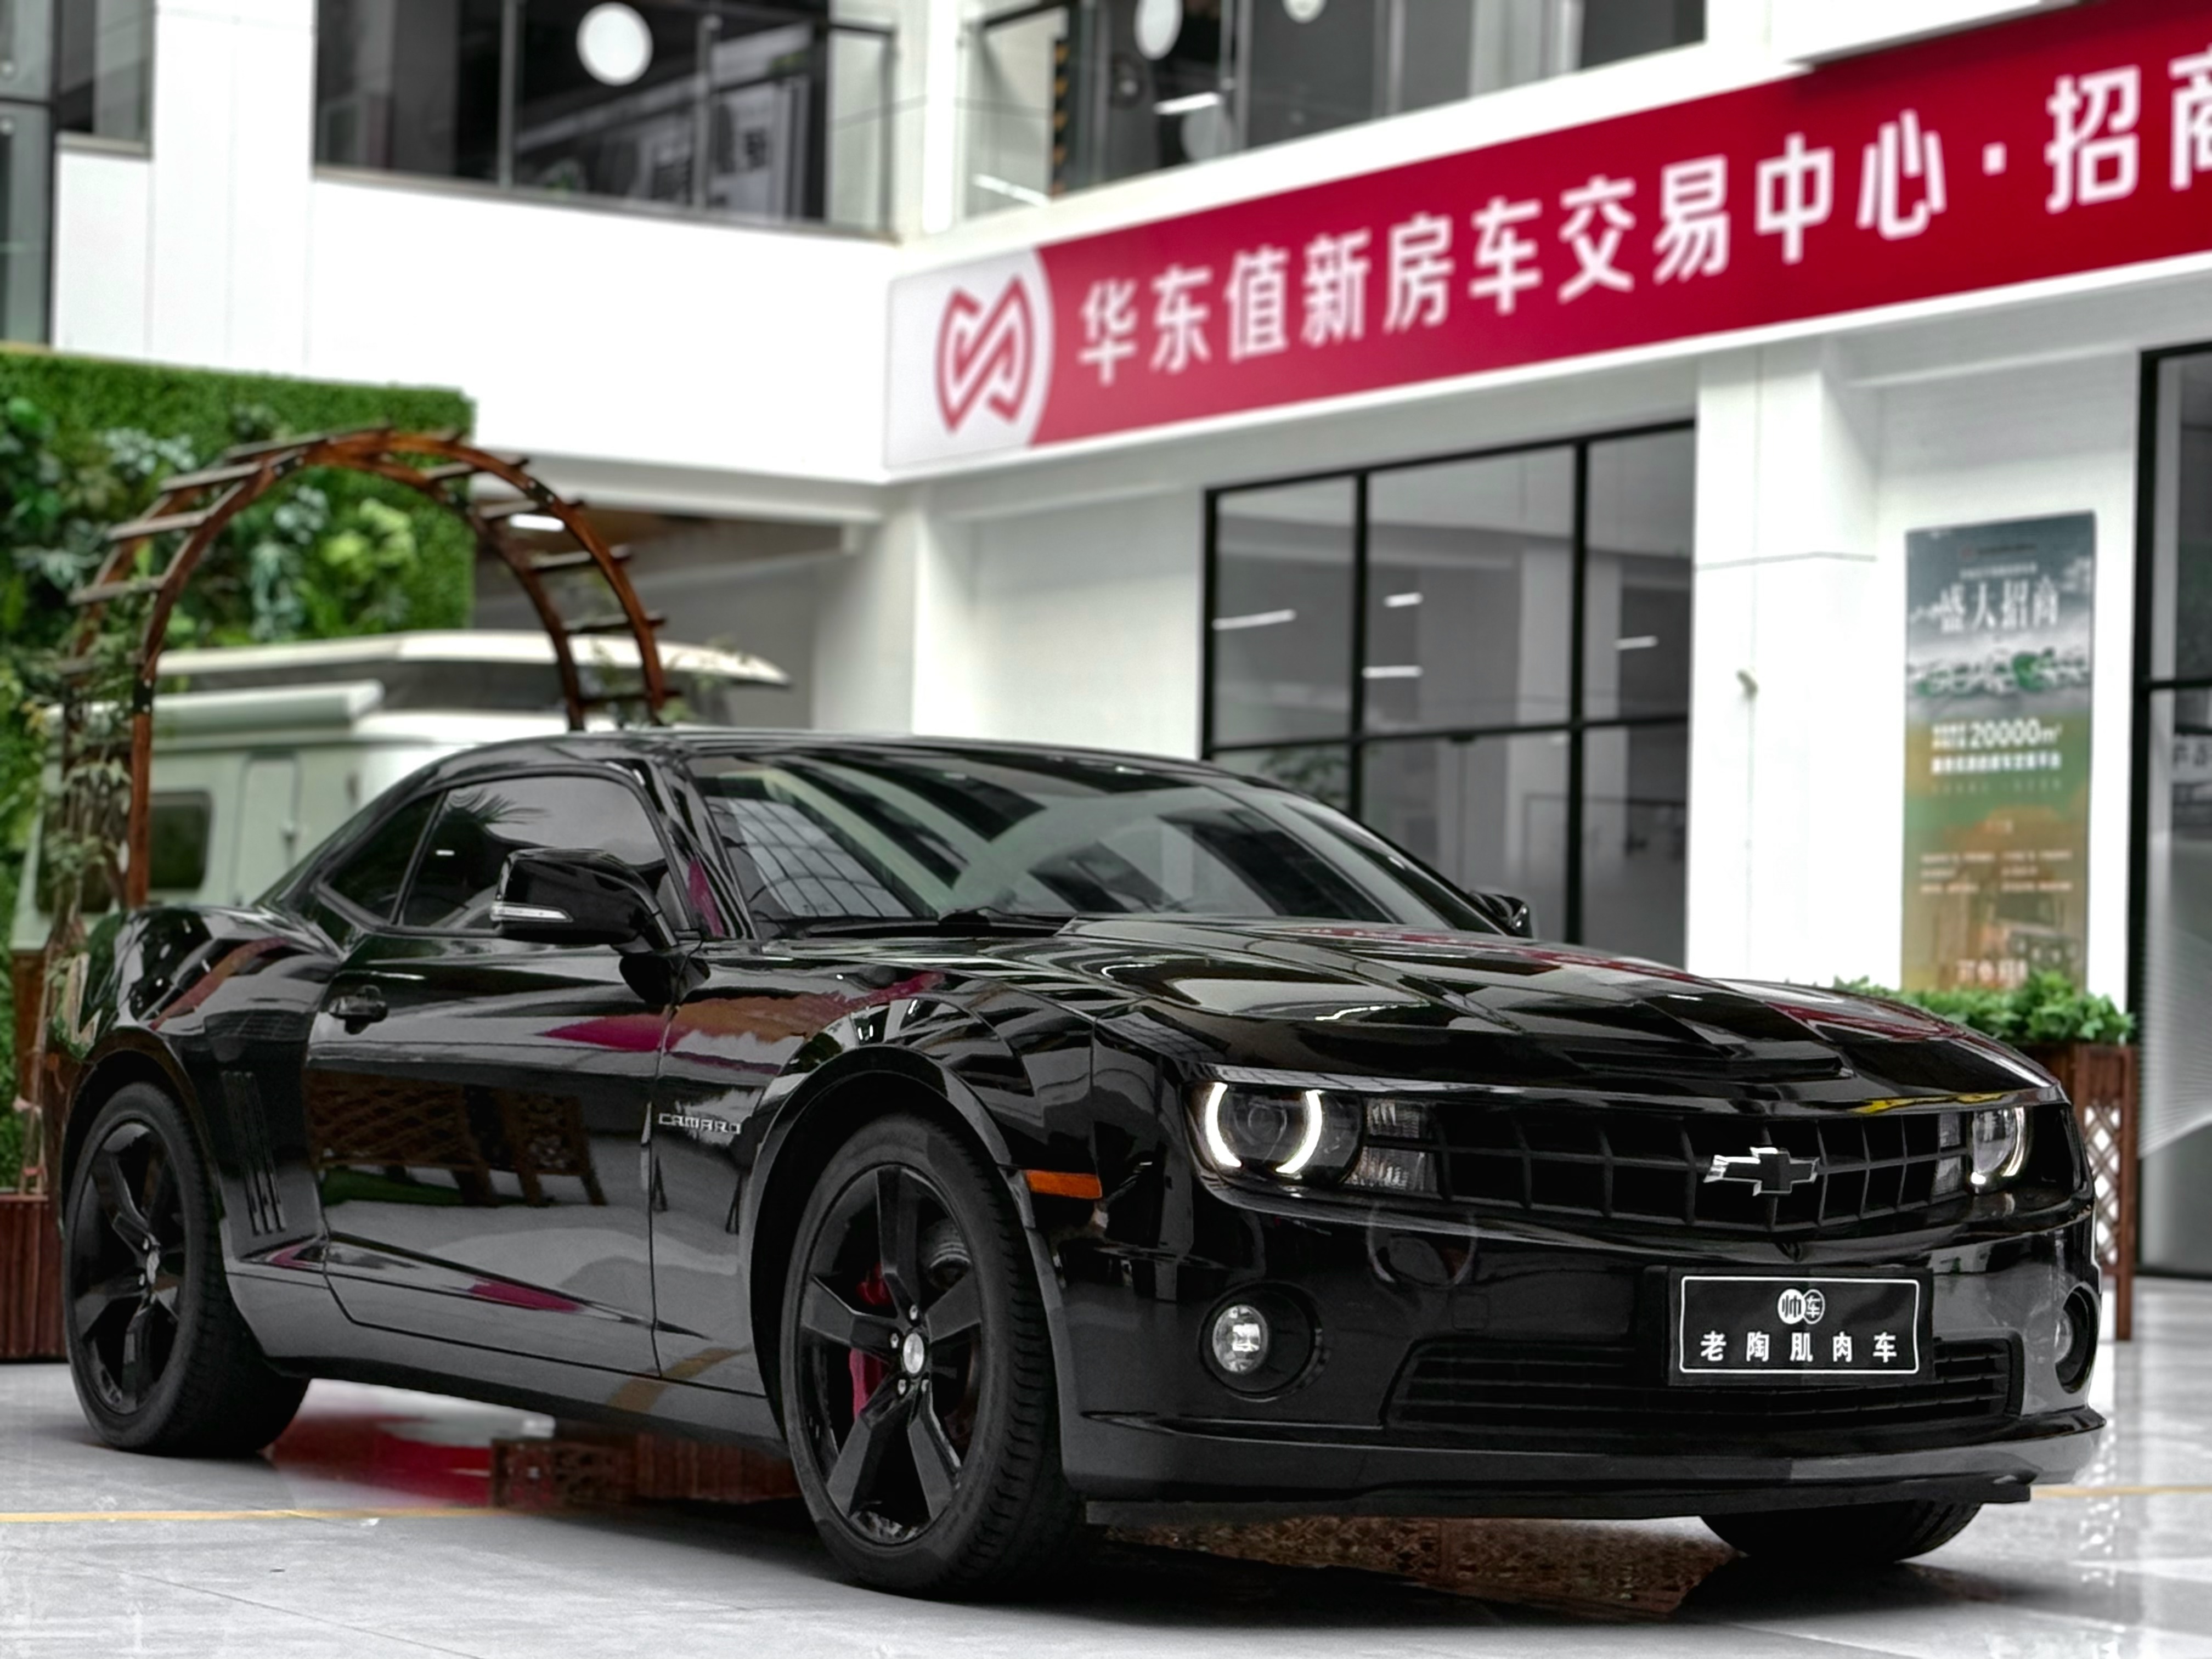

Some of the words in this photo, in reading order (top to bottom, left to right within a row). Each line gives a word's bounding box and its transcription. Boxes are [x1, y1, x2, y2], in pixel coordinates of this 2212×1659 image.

[658, 1112, 741, 1135] CAMARO
[1780, 1291, 1824, 1321] 帅车
[1700, 1330, 1898, 1363] 老陶肌肉车
